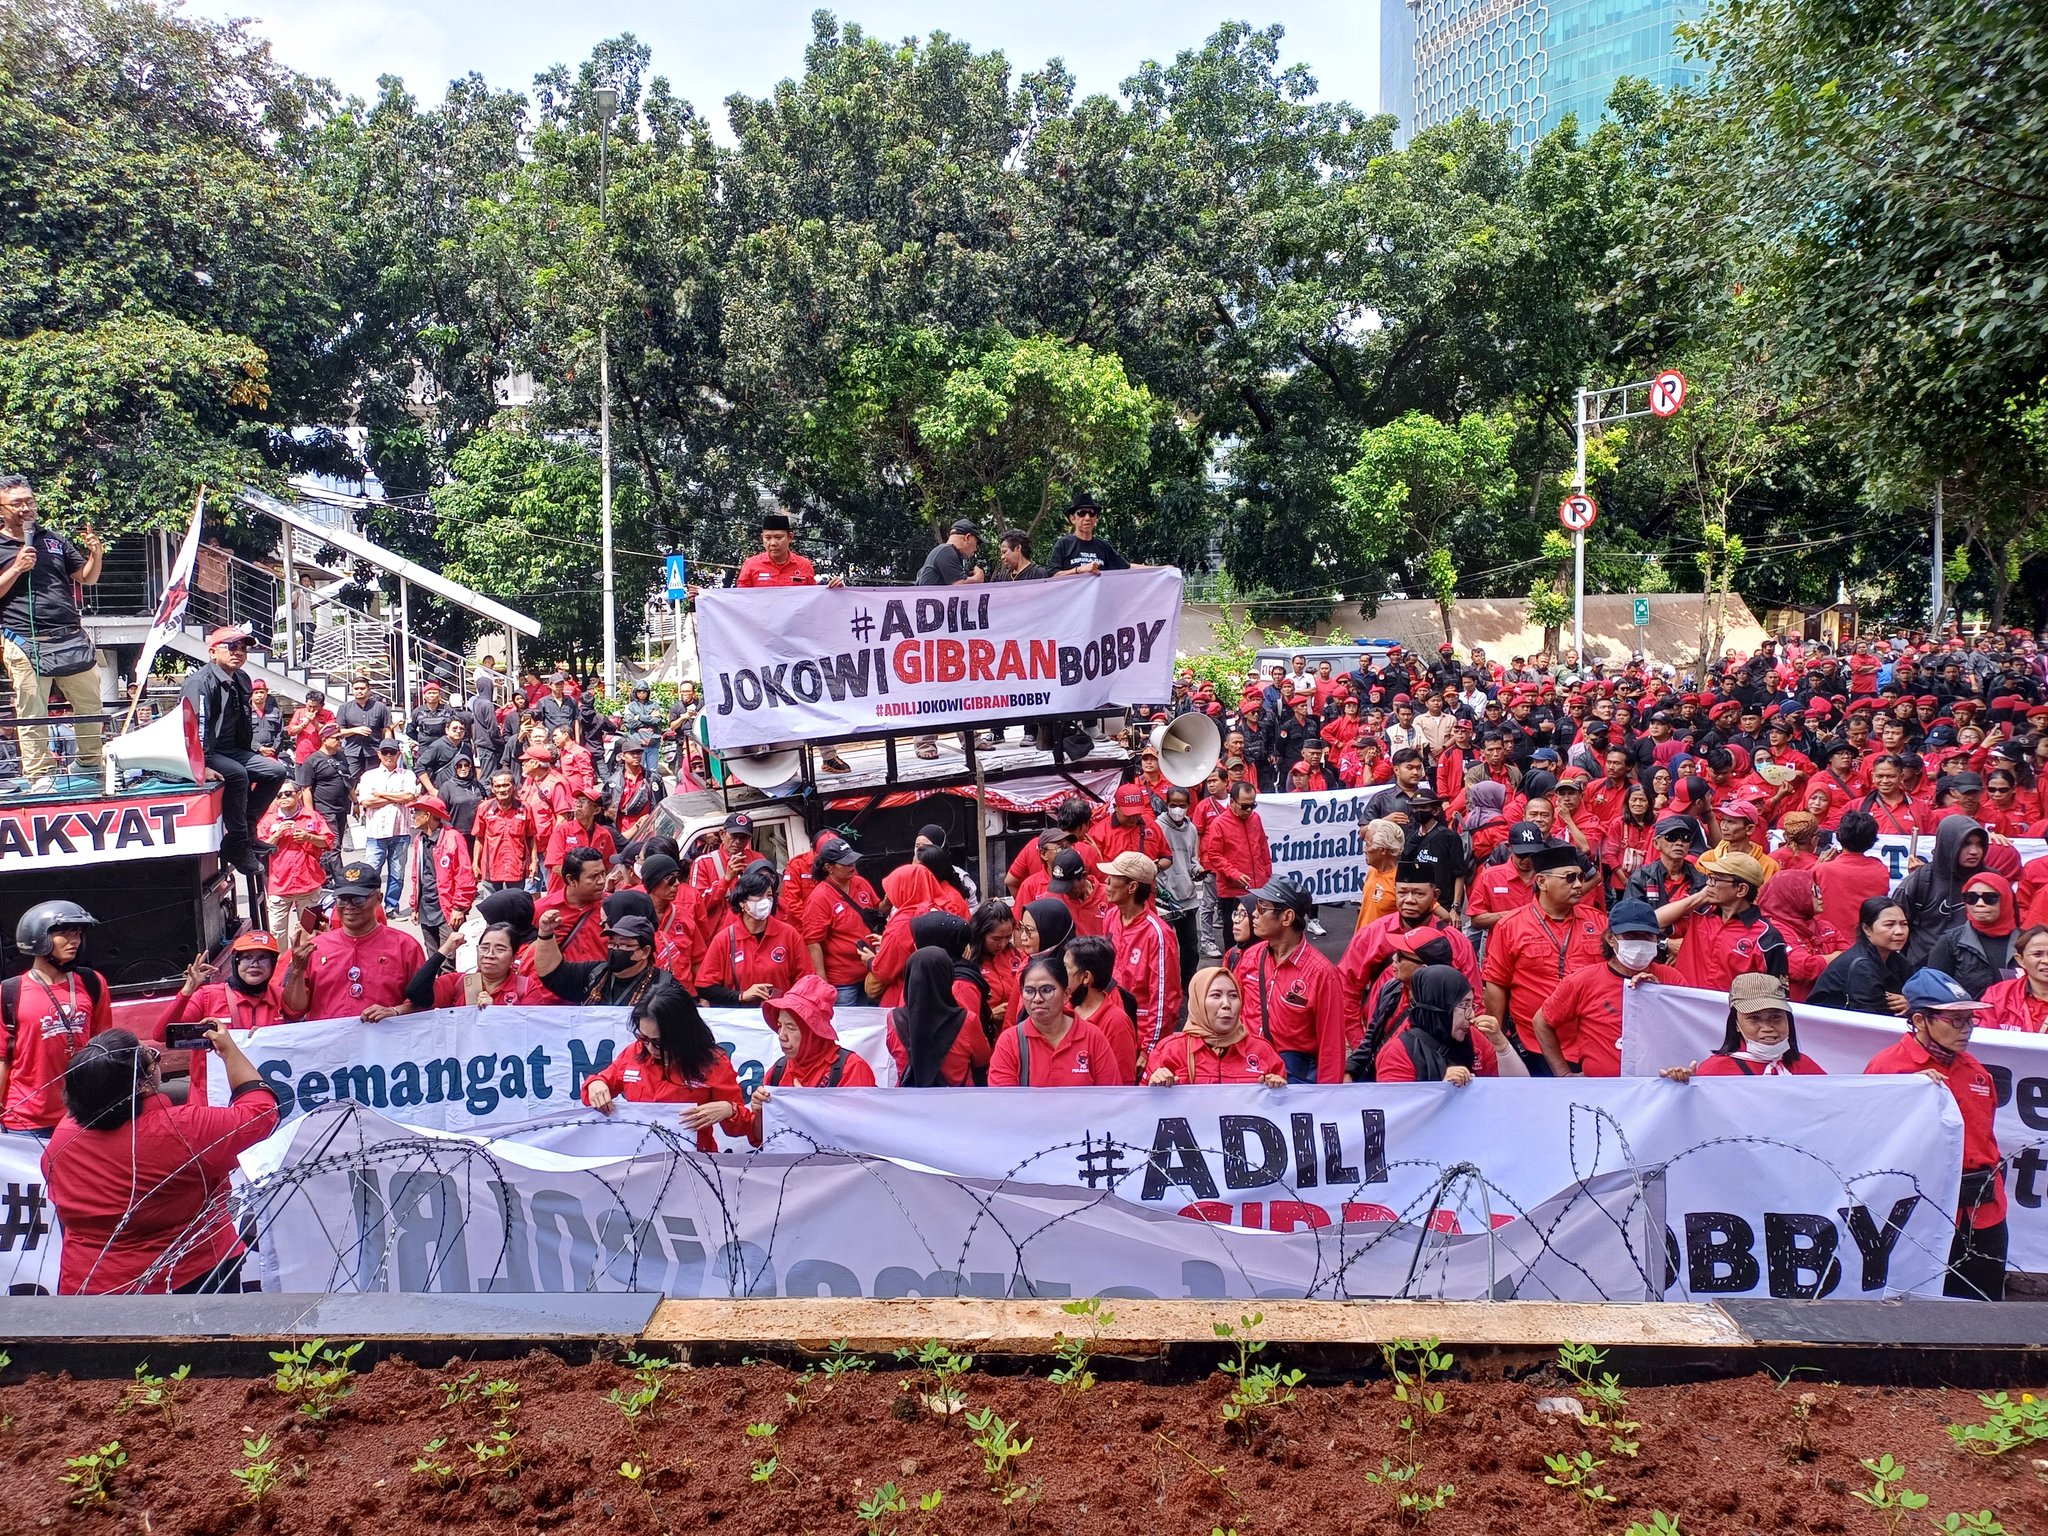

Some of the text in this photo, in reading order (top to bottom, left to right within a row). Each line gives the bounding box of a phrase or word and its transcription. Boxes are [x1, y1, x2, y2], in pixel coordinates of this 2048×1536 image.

[851, 594, 990, 643] #ADILI
[717, 619, 1167, 716] JOKOWI GIBRAN BOBBY
[876, 691, 1051, 717] #ADILIJOKOWIGIBRANBOBBY
[1300, 796, 1365, 825] Tolak
[1266, 829, 1363, 863] riminali
[256, 1044, 554, 1121] Semangat
[1075, 1109, 1389, 1201] #ADILI
